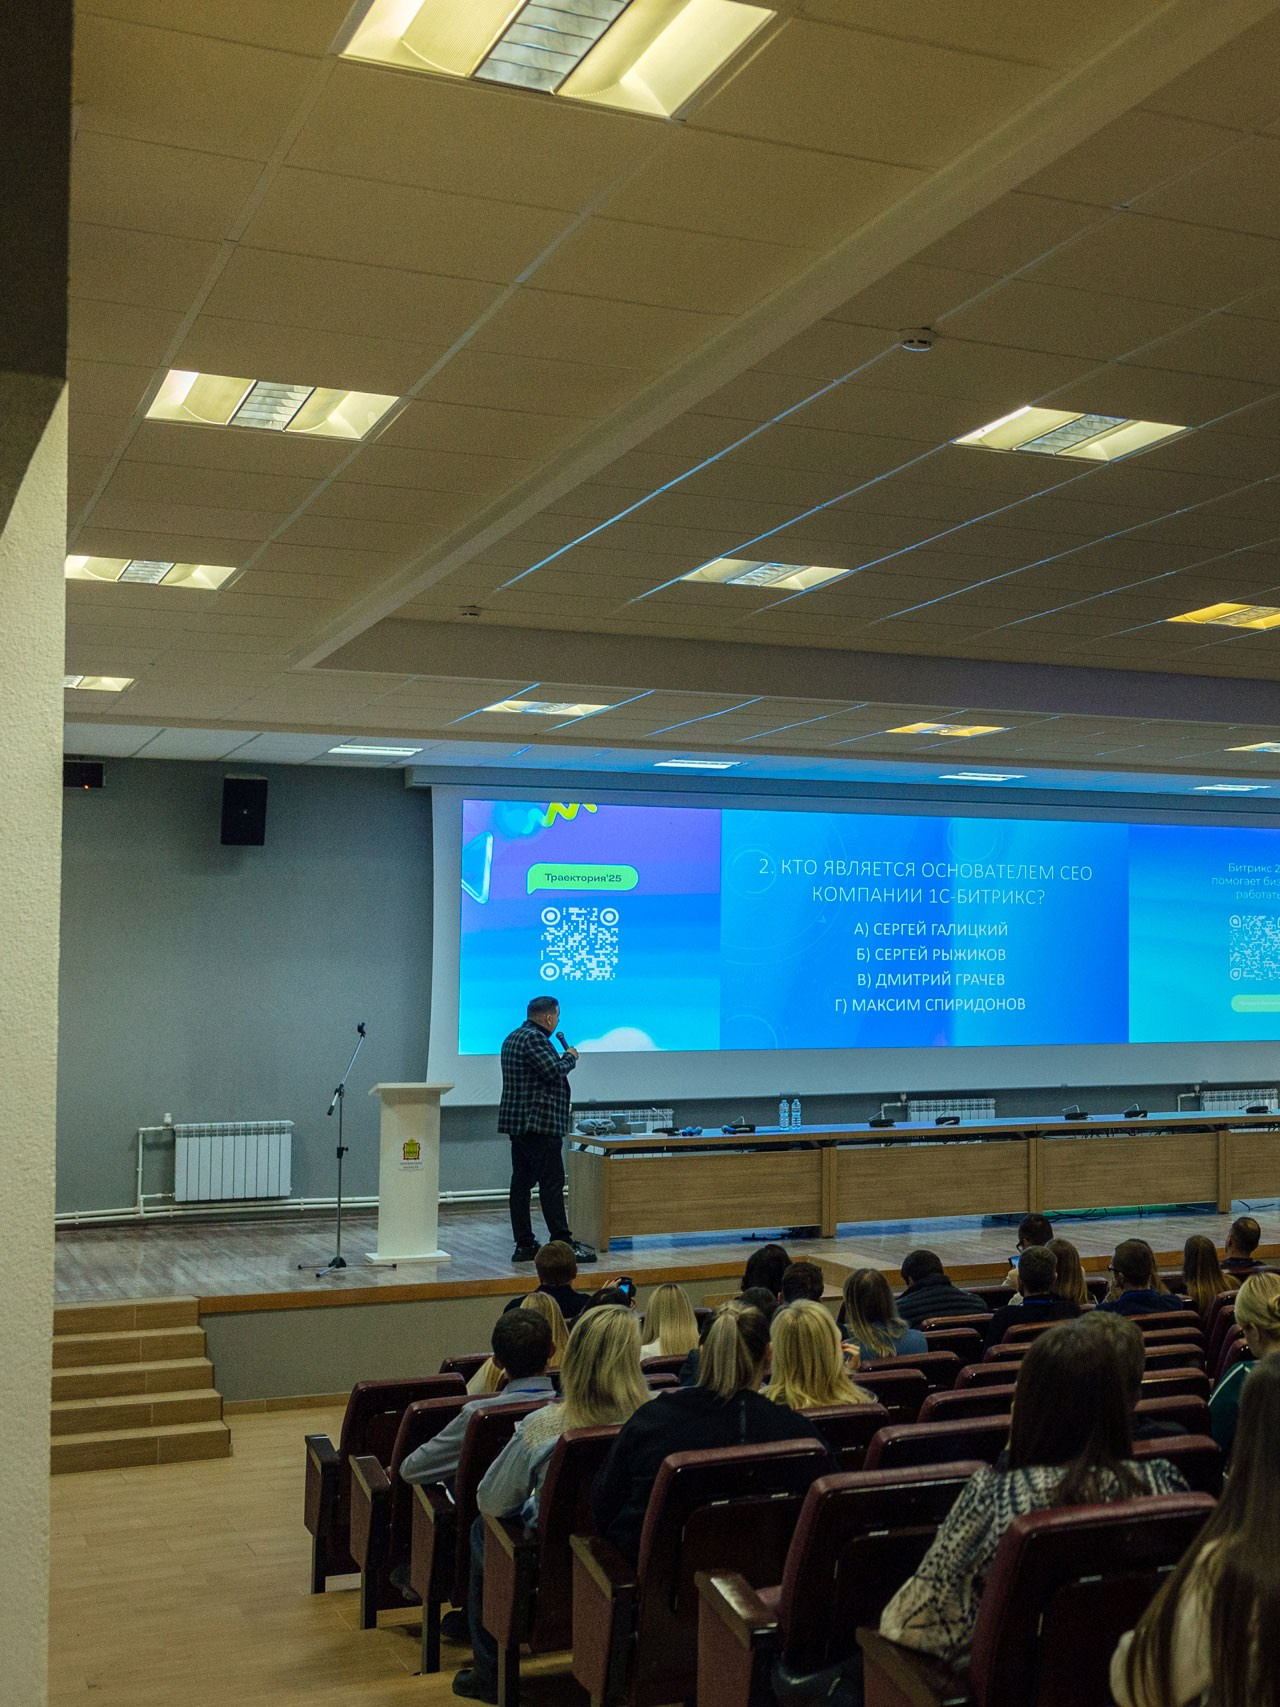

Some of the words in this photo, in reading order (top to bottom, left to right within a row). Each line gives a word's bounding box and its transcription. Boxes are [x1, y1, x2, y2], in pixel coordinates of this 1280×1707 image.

[759, 858, 775, 874] 2.
[781, 859, 817, 875] КТО
[823, 860, 915, 877] ЯВЛЯЕТСЯ
[921, 862, 1054, 880] ОСНОВАТЕЛЕМ
[1228, 863, 1272, 874] Битрикс
[545, 873, 622, 883] Траектория'25
[1211, 877, 1261, 887] помогает
[812, 886, 922, 903] КОМПАНИИ
[928, 888, 1045, 905] 1С-БИТРИКС?
[854, 922, 869, 937] А)
[873, 920, 927, 936] СЕРГЕЙ
[931, 920, 1008, 939] ГАЛИЦКИЙ
[856, 948, 871, 963] Б)
[875, 945, 928, 961] СЕРГЕЙ
[932, 948, 1006, 961] РЫЖИКОВ
[857, 973, 871, 987] В)
[875, 970, 951, 989] ДМИТРИЙ
[955, 973, 1005, 986] ГРАЧЕВ
[835, 999, 847, 1014] Г)
[852, 999, 920, 1012] МАКСИМ
[925, 996, 1026, 1013] СПИРИДОНОВ
